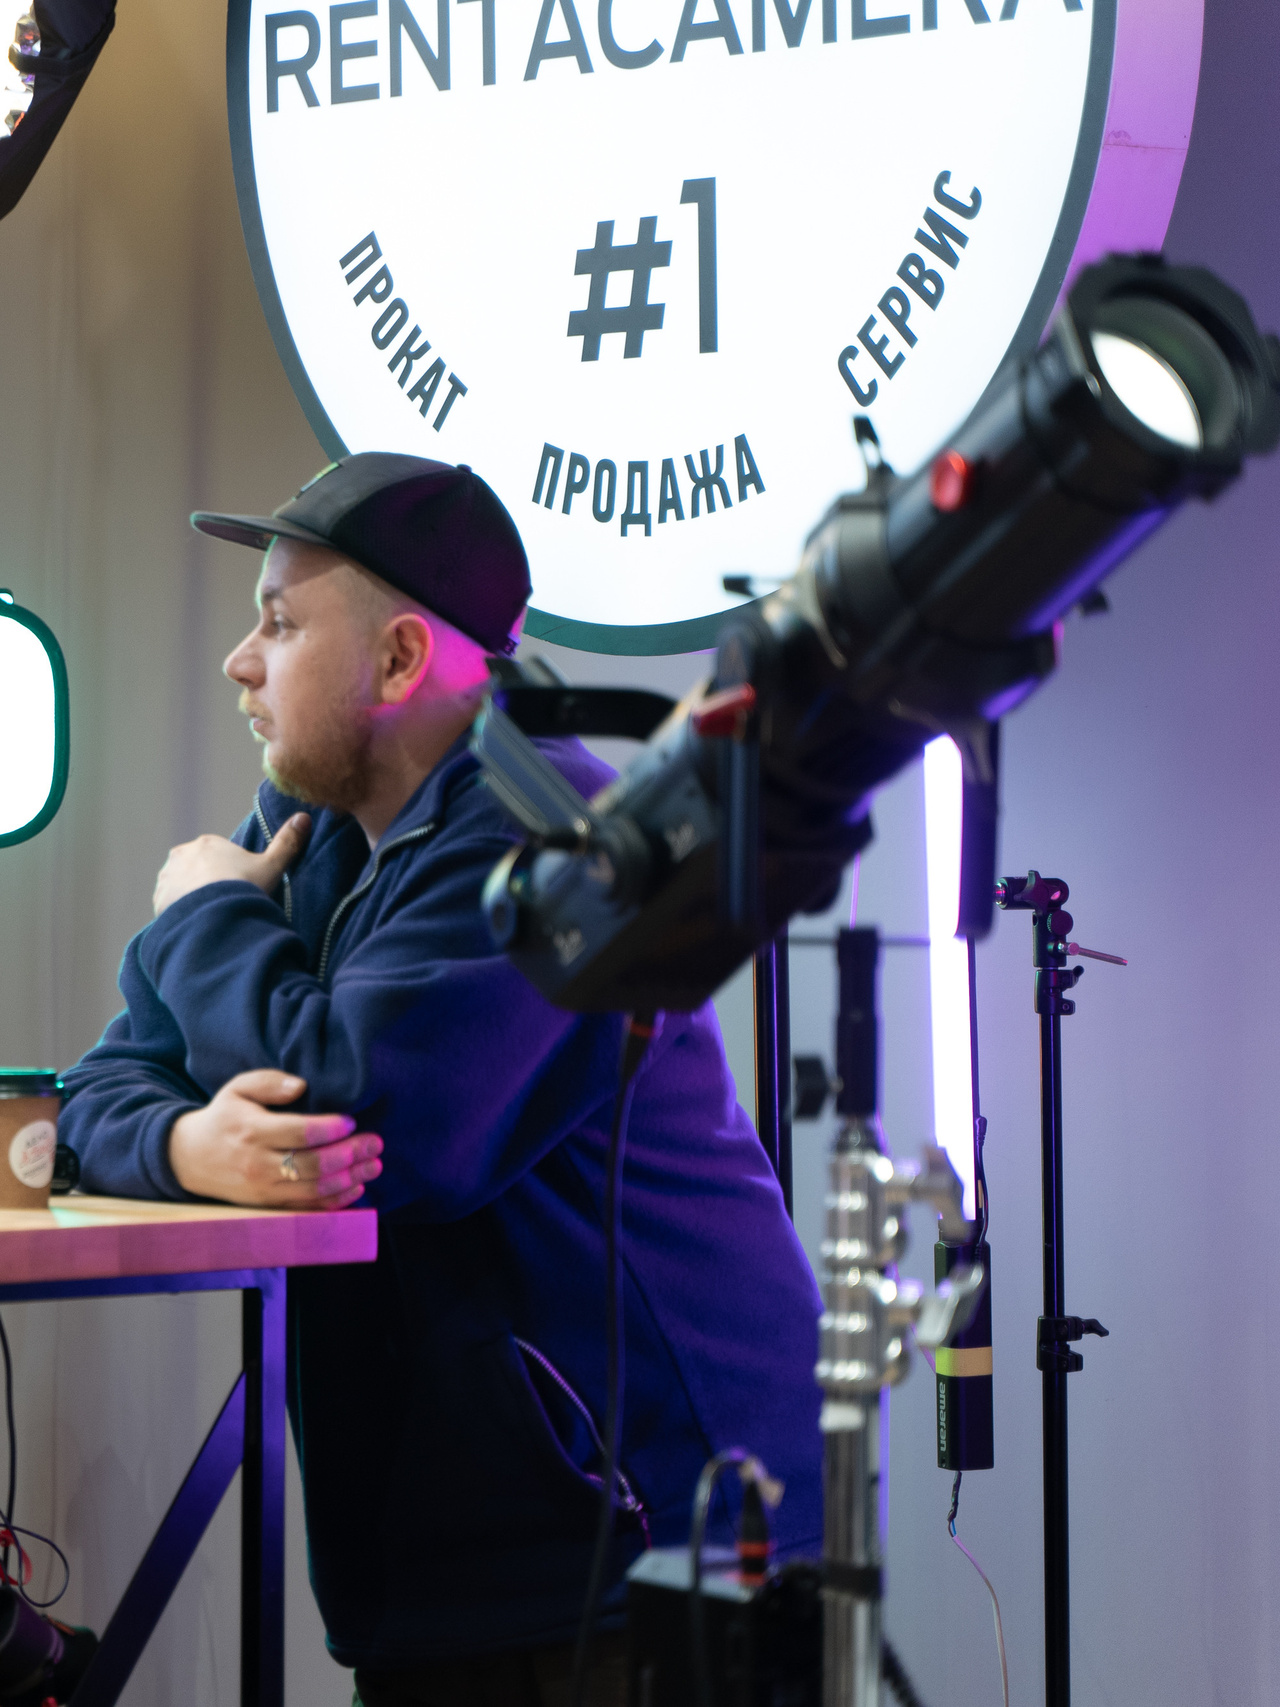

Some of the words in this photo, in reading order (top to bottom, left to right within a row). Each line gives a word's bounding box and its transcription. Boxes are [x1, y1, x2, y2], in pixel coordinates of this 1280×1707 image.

[265, 0, 1084, 113] RENTACAM
[339, 230, 469, 433] ПРОКАТ
[567, 177, 718, 362] #1
[838, 171, 983, 408] СЕРВИС
[532, 433, 766, 538] ПРОДАЖА
[939, 1381, 947, 1452] amaran
